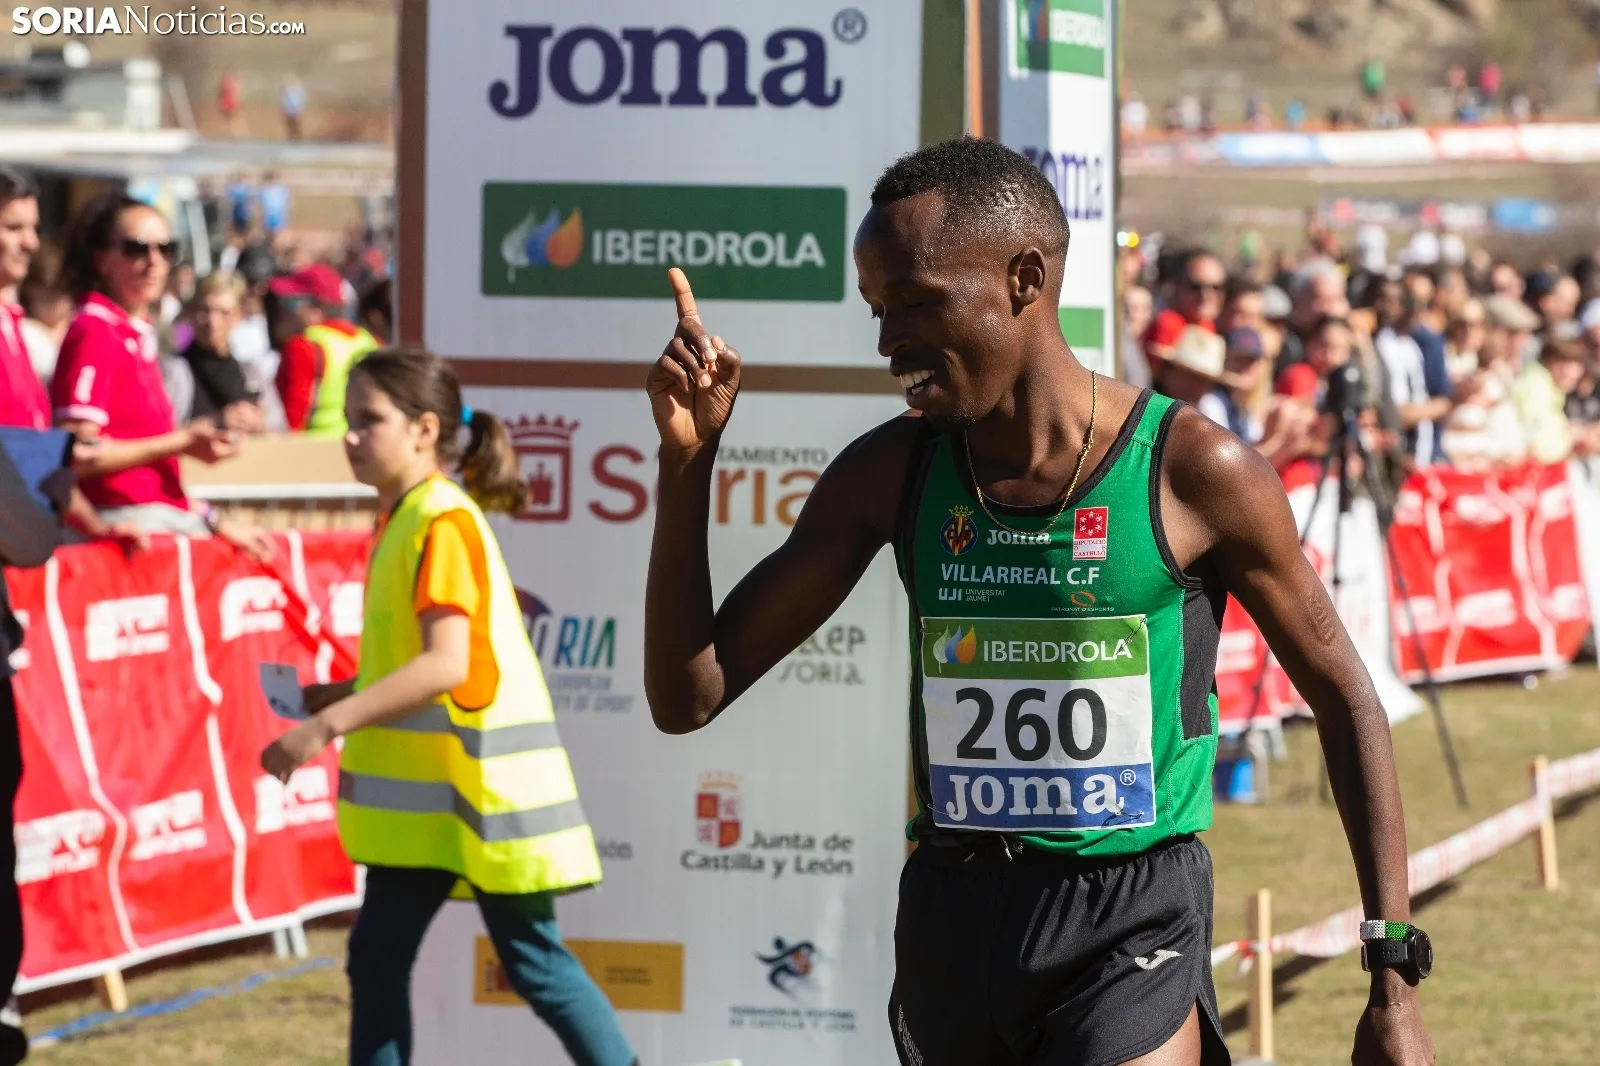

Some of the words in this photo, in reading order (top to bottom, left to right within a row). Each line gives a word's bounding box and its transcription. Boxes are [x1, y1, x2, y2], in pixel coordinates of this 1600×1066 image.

[592, 230, 826, 268] IBERDROLA
[941, 563, 1061, 585] VILLARREAL
[1066, 567, 1100, 585] C.F
[965, 588, 1006, 597] UNIVERSITAT
[984, 639, 1133, 663] IBERDROLA
[955, 687, 1108, 762] 260
[748, 830, 816, 850] Junta
[822, 833, 854, 851] de
[680, 849, 765, 871] Castilla
[772, 854, 787, 879] y
[794, 854, 854, 875] León
